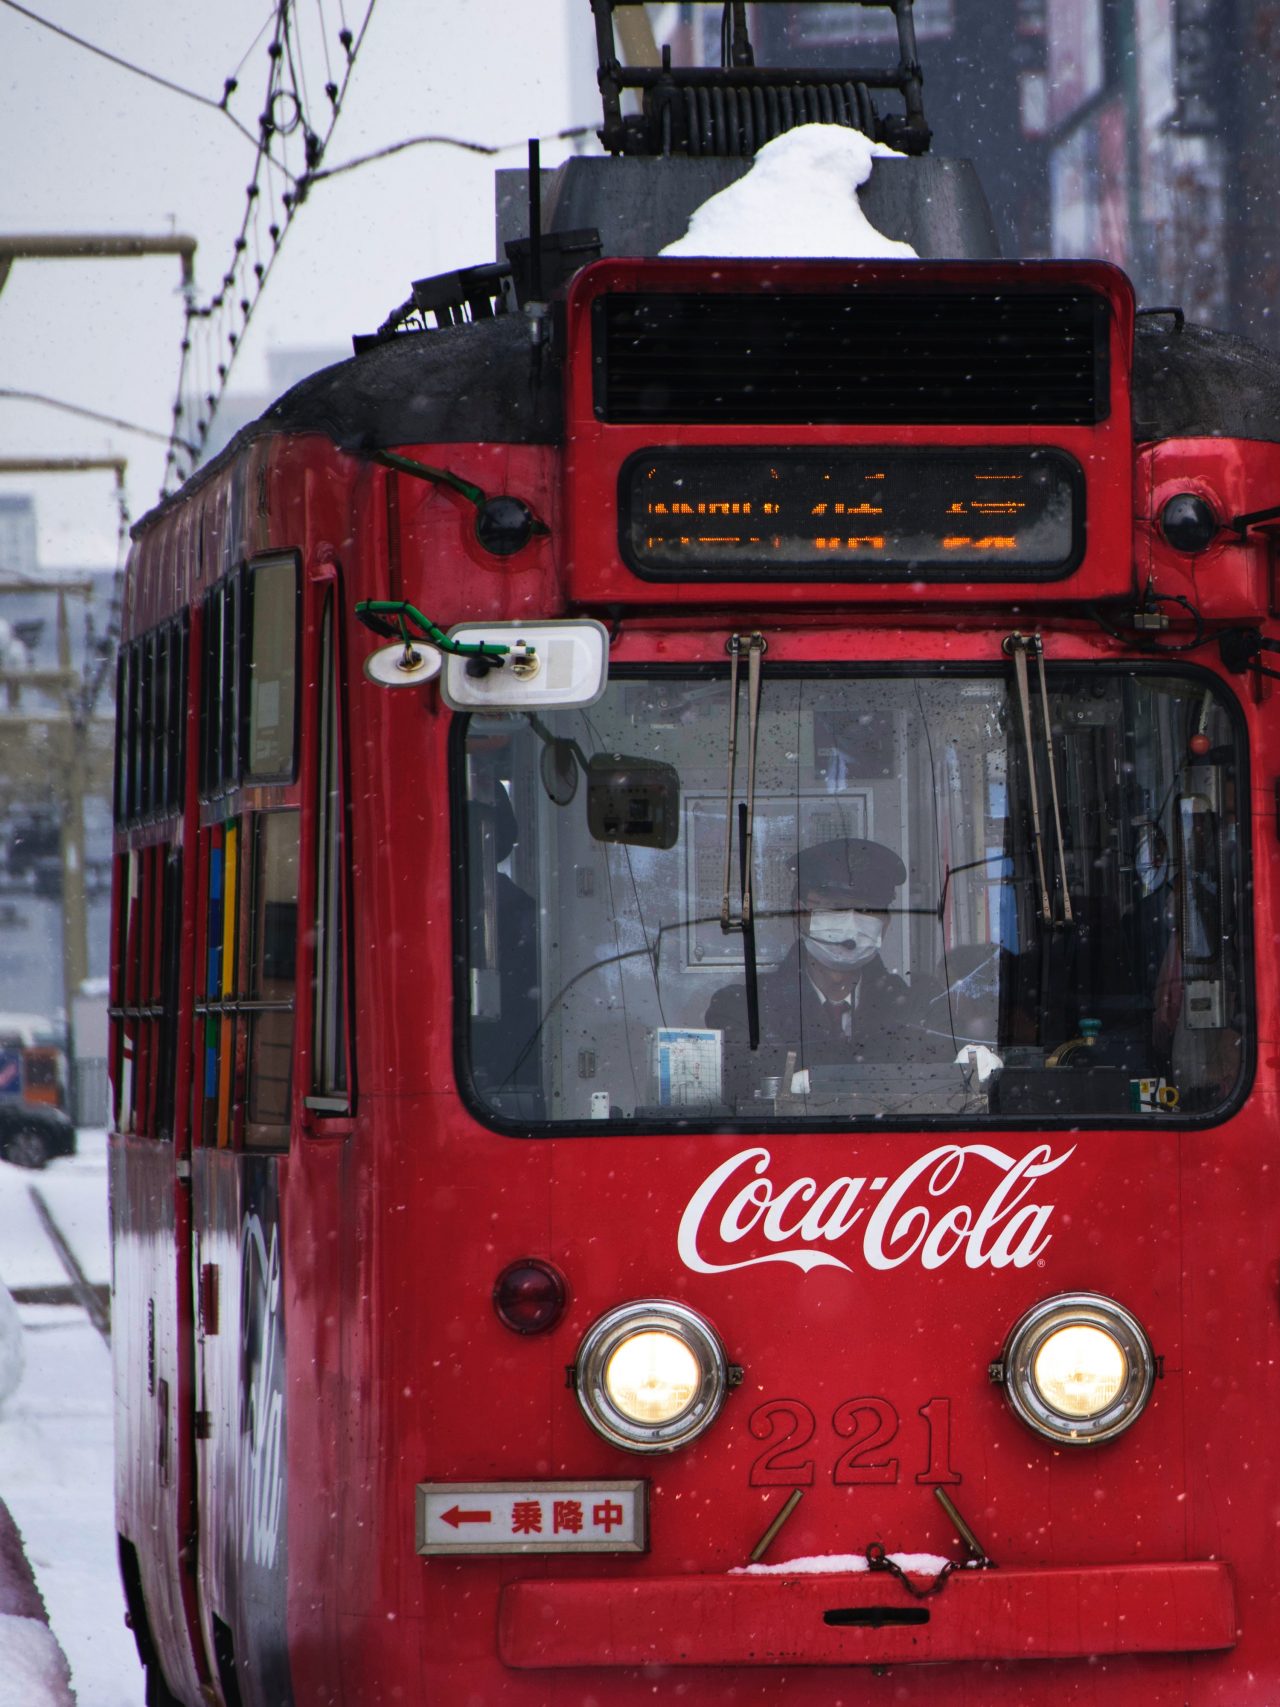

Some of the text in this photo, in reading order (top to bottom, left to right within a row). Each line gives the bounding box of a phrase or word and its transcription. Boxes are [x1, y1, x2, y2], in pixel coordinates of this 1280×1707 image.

[677, 1143, 1078, 1274] Coca-Cola
[749, 1397, 962, 1487] 221
[511, 1499, 623, 1535] 乗降中
